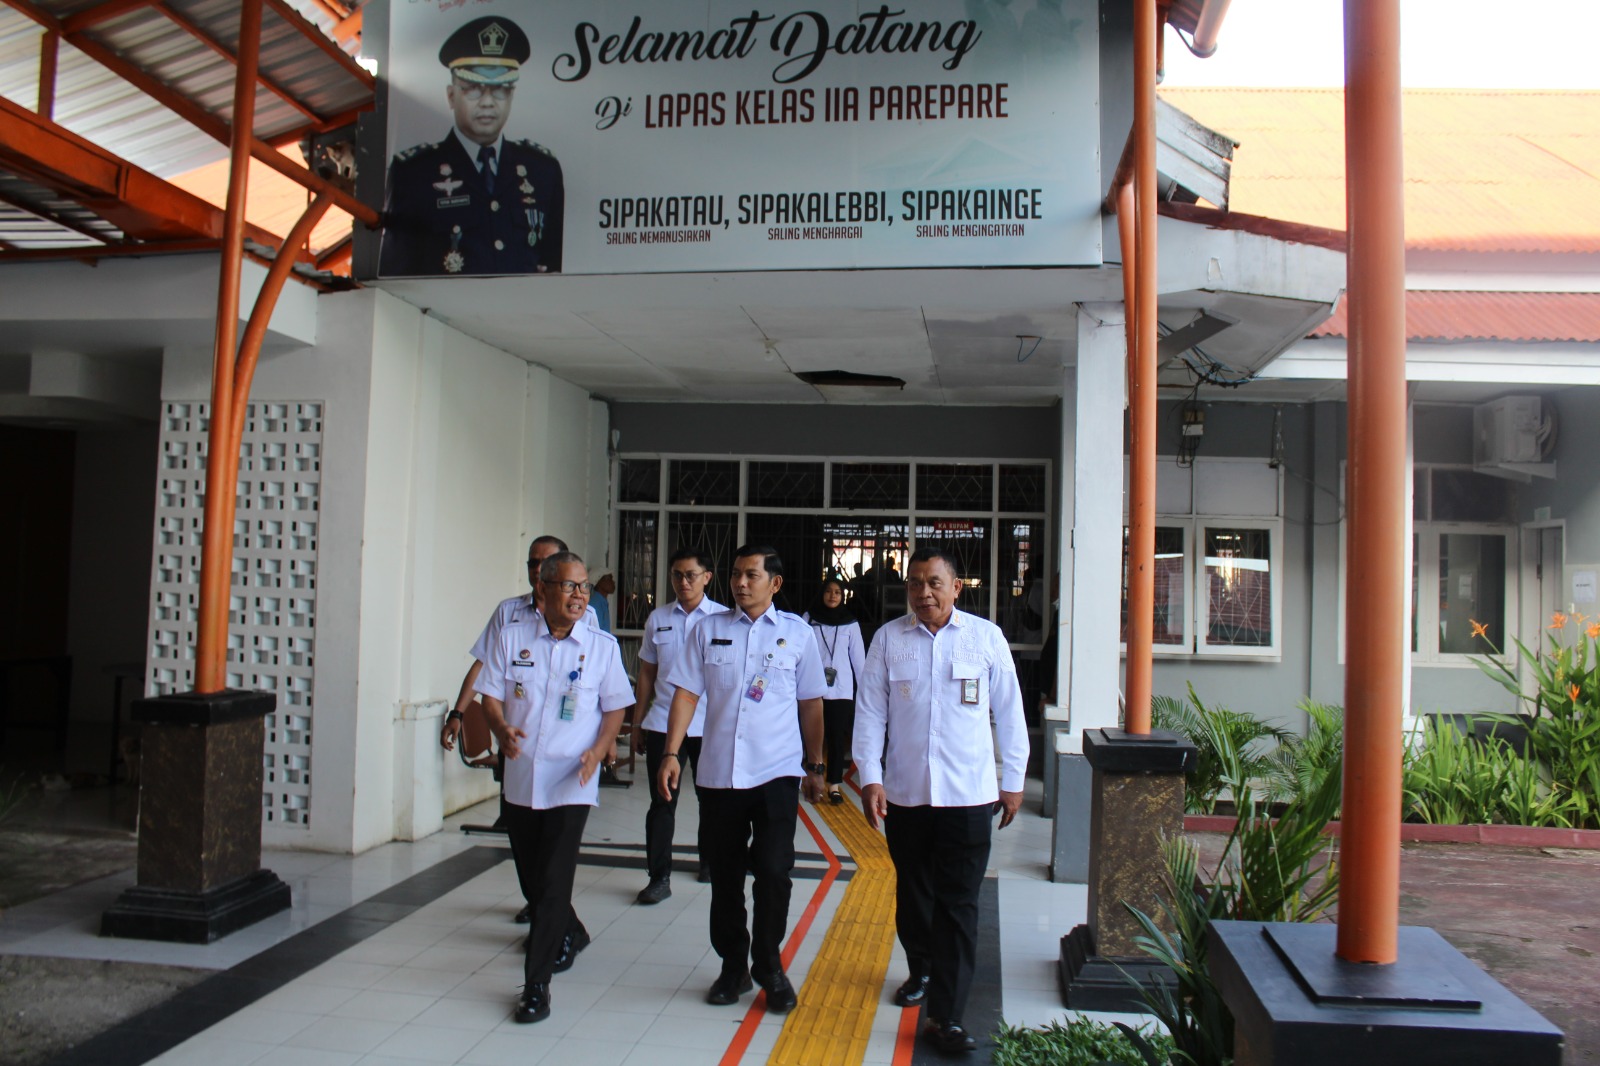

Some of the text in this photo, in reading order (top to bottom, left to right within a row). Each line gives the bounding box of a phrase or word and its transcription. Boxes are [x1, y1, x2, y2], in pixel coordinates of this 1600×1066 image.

[552, 4, 983, 84] Selamat Datang
[595, 83, 1009, 130] Di LAPAS KELAS IIA PAREPARE
[599, 188, 1043, 230] SIPAKATAU, SIPAKALEBBI, SIPAKAINGE
[606, 229, 711, 245] SALING MEMANUSIAKAN
[768, 226, 863, 241] SALING MENGHARGAI
[916, 223, 1025, 238] SALING MENGINGATKAN
